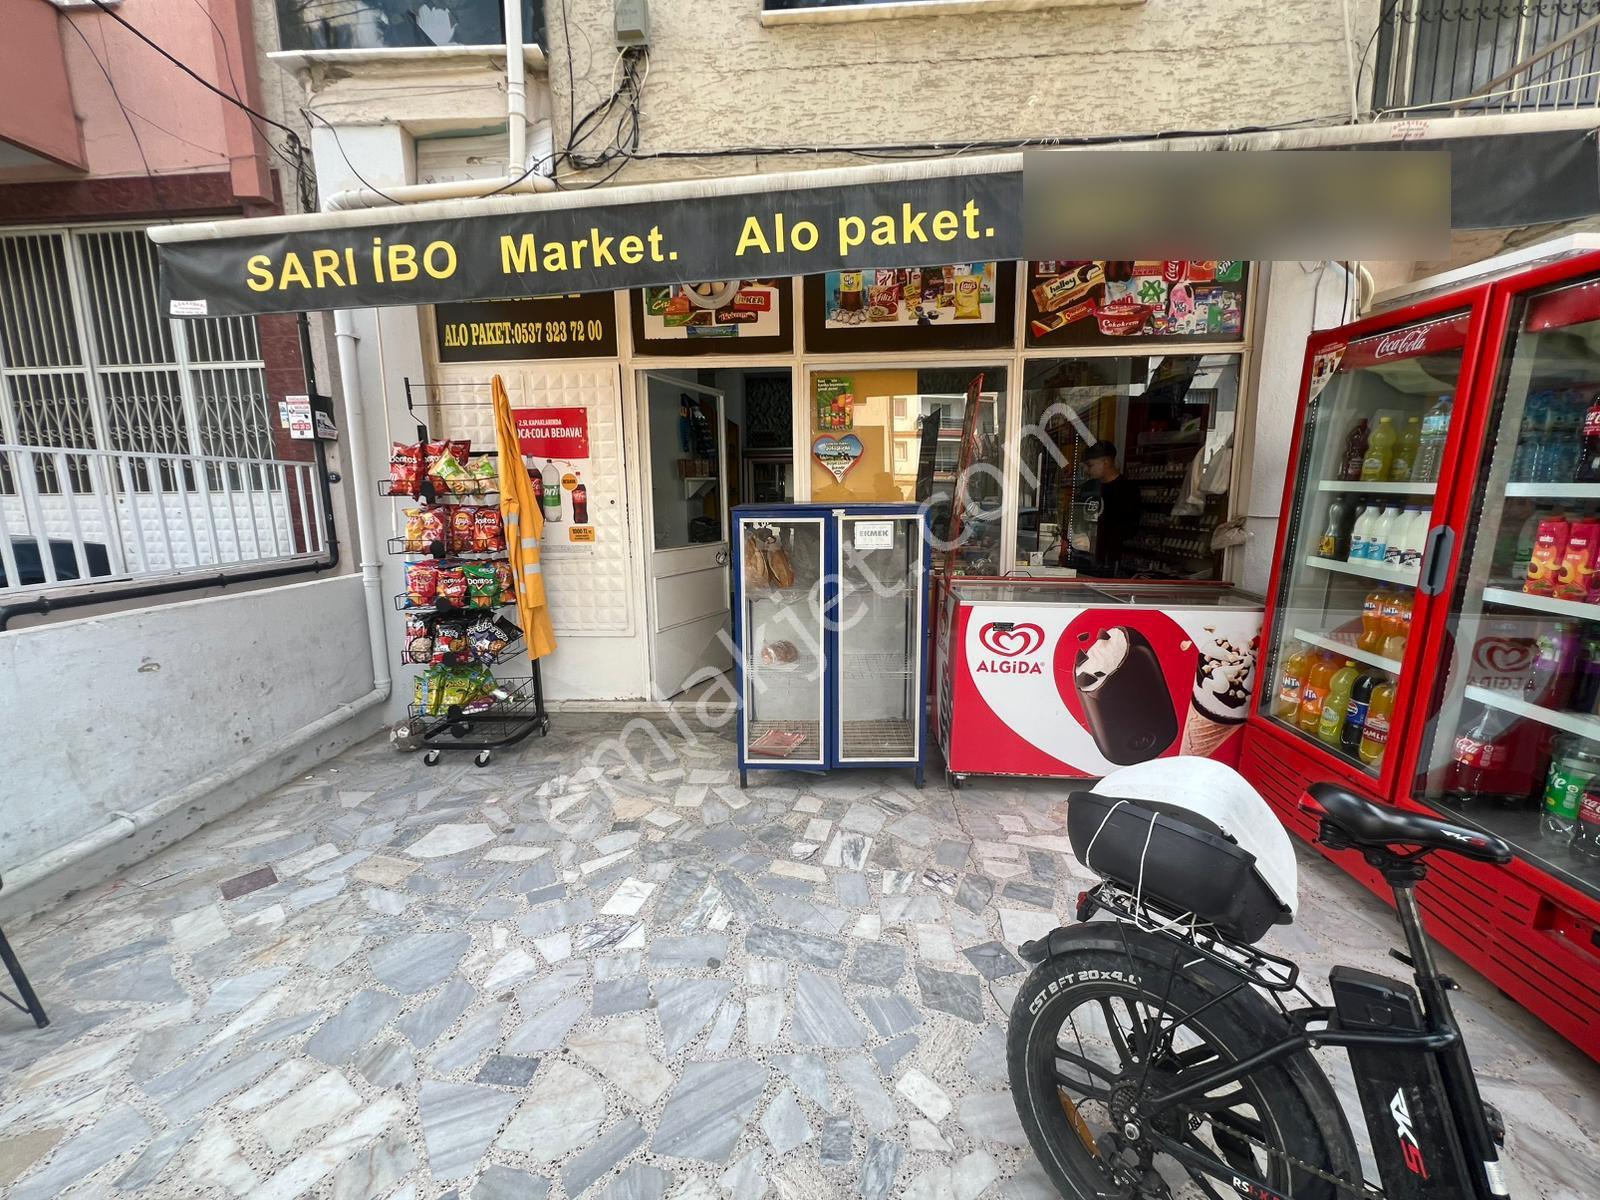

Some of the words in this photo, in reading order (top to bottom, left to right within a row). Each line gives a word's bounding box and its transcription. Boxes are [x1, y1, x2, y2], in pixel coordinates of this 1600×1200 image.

[246, 247, 358, 292] SARI
[373, 237, 457, 283] İBO
[500, 225, 679, 274] Market.
[735, 212, 819, 256] Alo
[838, 199, 996, 255] paket.
[1050, 277, 1076, 293] halley
[444, 323, 468, 347] ALO
[470, 321, 542, 346] PAKET:0537
[546, 320, 567, 343] 323
[570, 320, 584, 342] 72
[587, 319, 603, 341] 00
[551, 427, 583, 438] BEDAVA!
[1028, 989, 1048, 1016] CST
[1047, 973, 1075, 994] BFT
